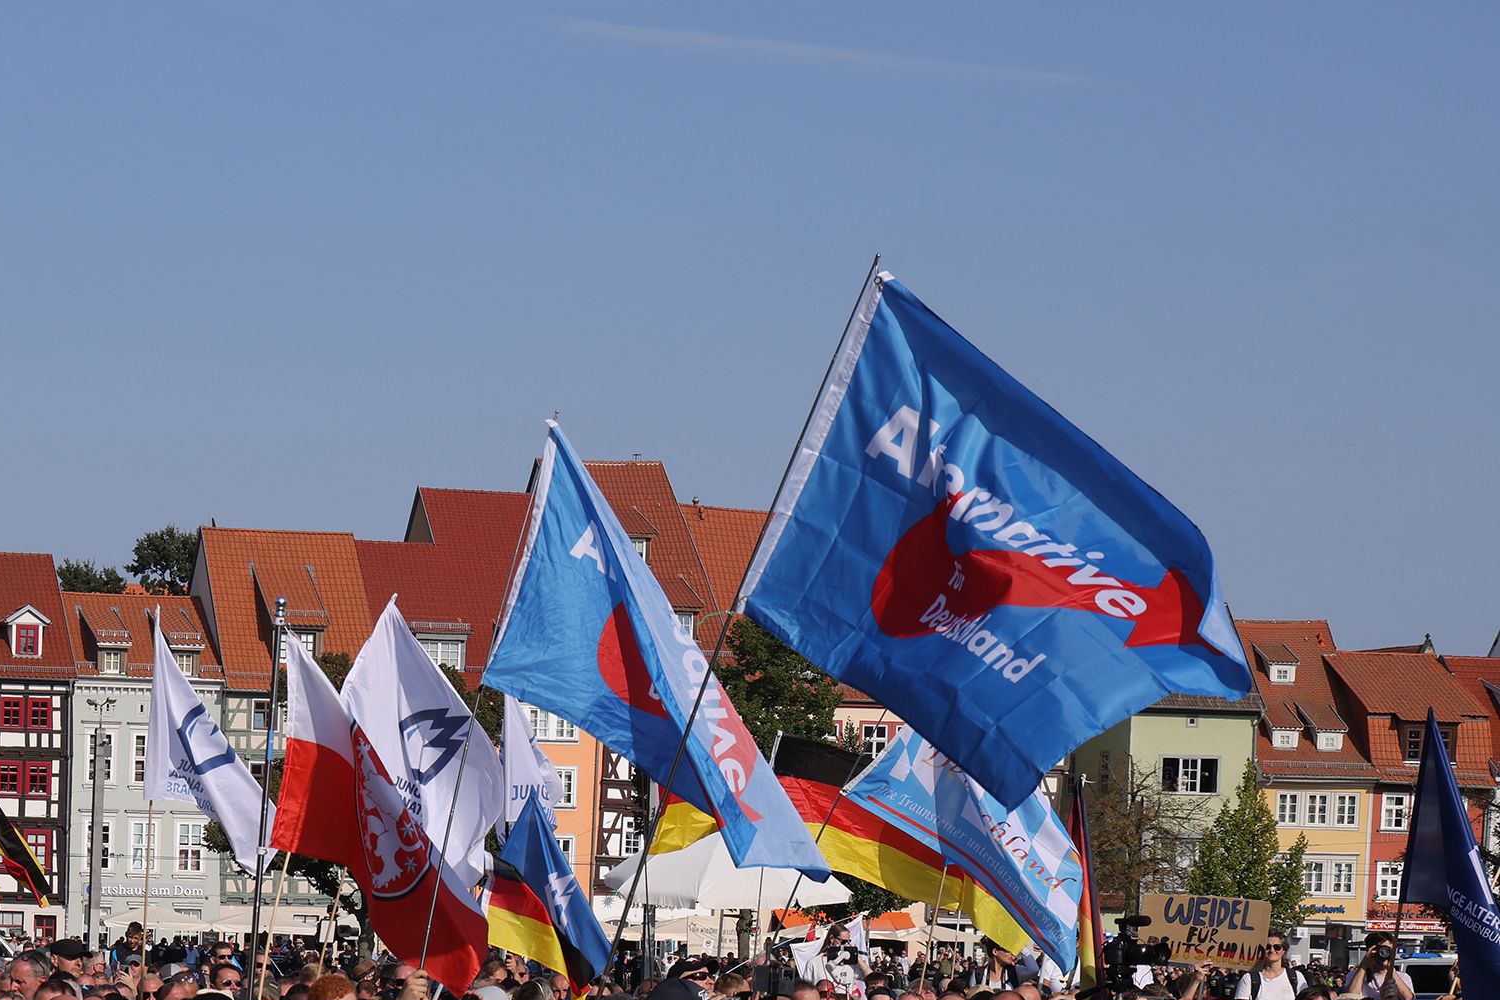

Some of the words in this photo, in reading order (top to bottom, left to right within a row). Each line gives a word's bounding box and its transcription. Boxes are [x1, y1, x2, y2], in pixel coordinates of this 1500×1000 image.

[151, 886, 171, 896] am
[173, 885, 203, 897] Dom
[1163, 896, 1255, 931] WEIDEL
[1186, 926, 1219, 944] FÜR
